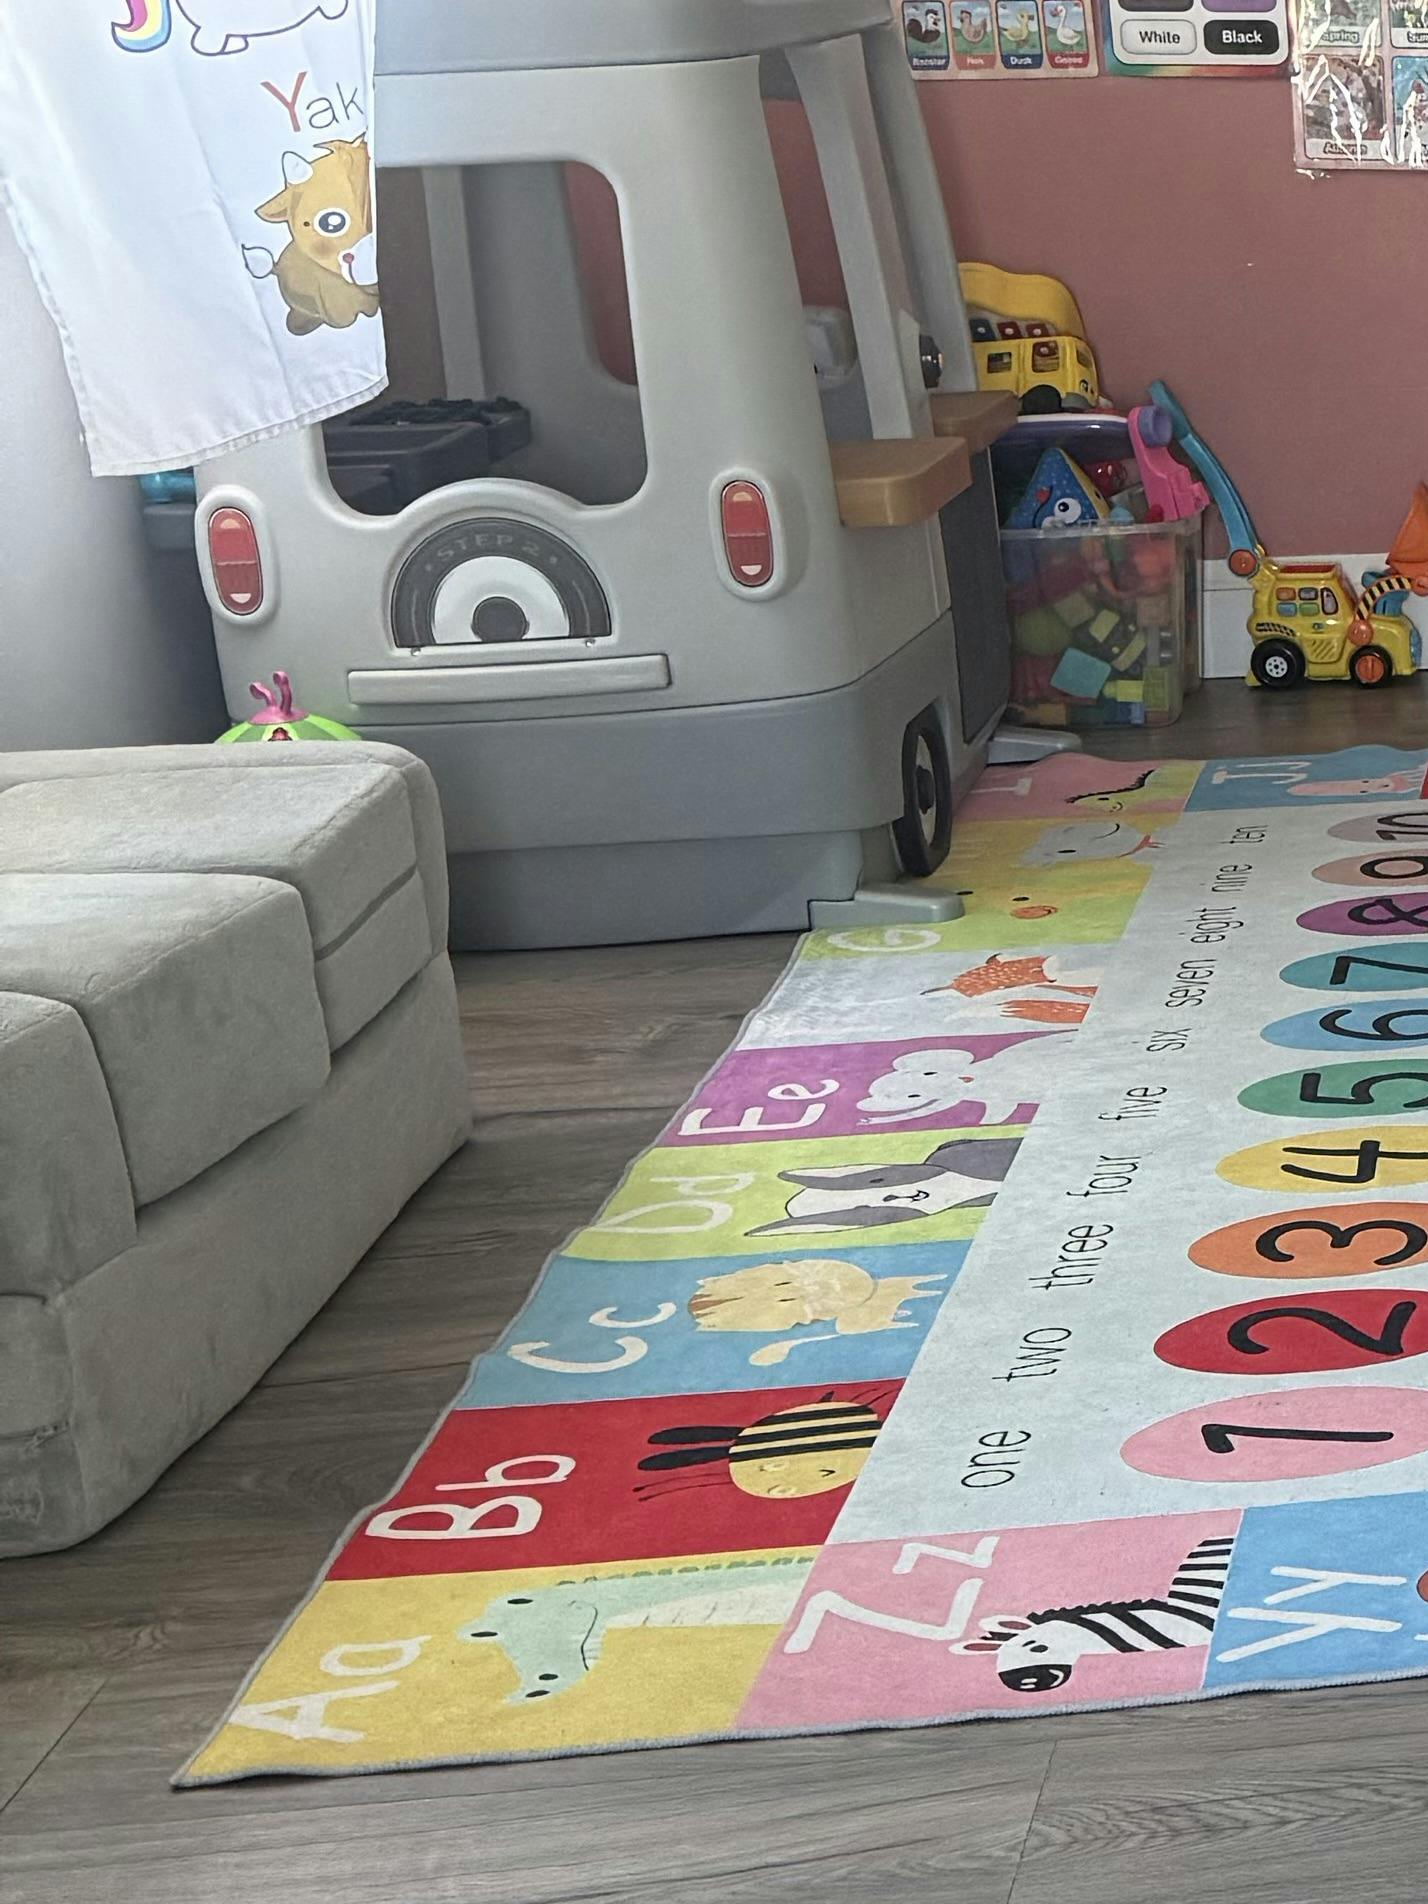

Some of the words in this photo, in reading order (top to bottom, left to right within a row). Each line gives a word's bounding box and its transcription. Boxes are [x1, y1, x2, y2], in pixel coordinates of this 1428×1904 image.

[1138, 29, 1181, 45] White
[1222, 28, 1263, 45] Black
[261, 71, 365, 133] Yak
[437, 533, 514, 558] STEP
[1219, 822, 1270, 845] ten
[1200, 861, 1253, 894] nine
[826, 928, 942, 952] G
[1180, 904, 1245, 945] eight
[1165, 955, 1215, 1010] seven
[1133, 1025, 1192, 1053] six
[676, 1077, 841, 1138] Ee
[1097, 1085, 1168, 1122] five
[602, 1171, 755, 1235] Dd
[1066, 1154, 1143, 1198] four
[1028, 1223, 1114, 1291] three
[1255, 1218, 1428, 1266] 3
[506, 1301, 678, 1374] Cc
[991, 1326, 1073, 1383] two
[1227, 1300, 1417, 1357] 2
[960, 1429, 1032, 1489] one
[1201, 1422, 1394, 1455] 1
[364, 1453, 578, 1541] Bb
[783, 1534, 1001, 1656] Zz
[1216, 1564, 1409, 1664] Yy
[228, 1635, 432, 1744] Aa
